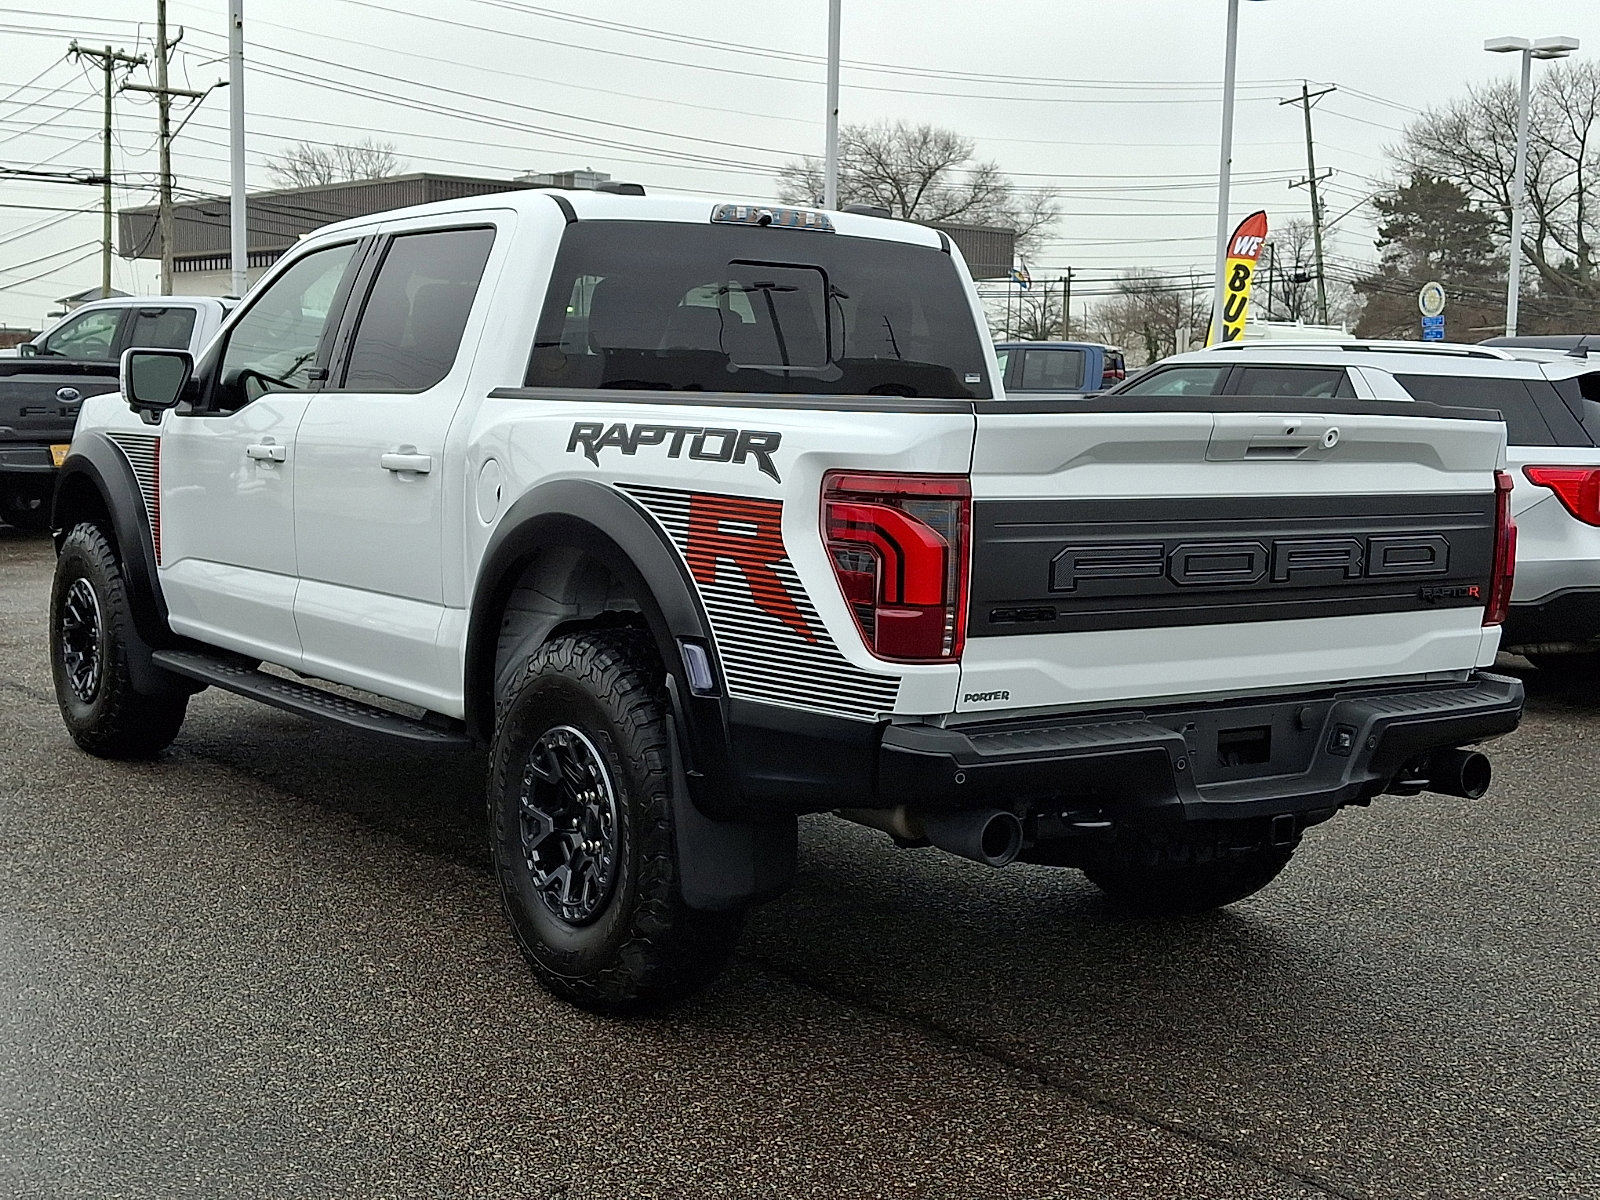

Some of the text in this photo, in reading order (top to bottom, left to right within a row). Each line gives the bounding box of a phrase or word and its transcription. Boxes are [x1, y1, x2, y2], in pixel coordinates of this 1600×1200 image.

[1233, 236, 1263, 256] WE
[566, 421, 782, 484] RAPTOR
[1050, 533, 1450, 592] FORD
[963, 690, 1010, 703] PORTER
